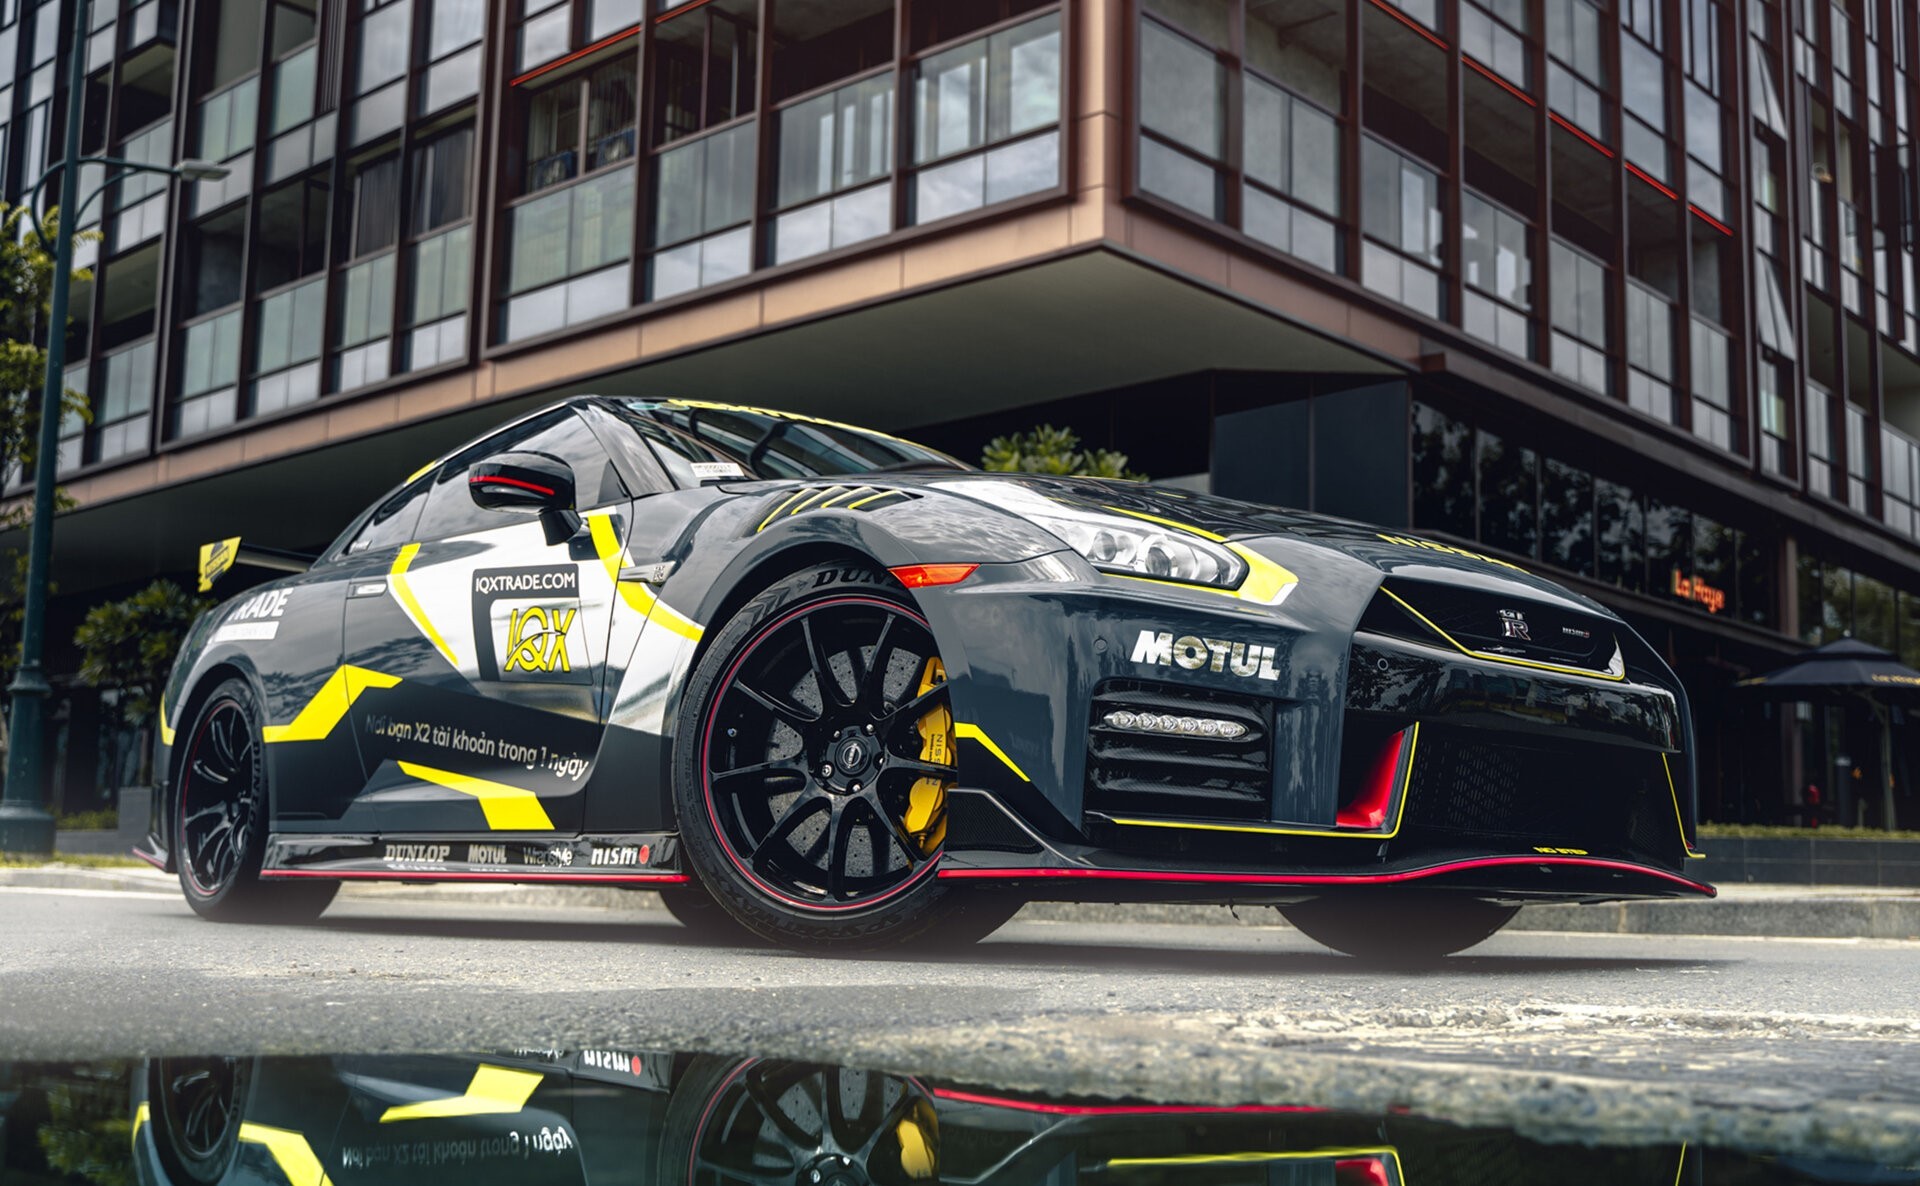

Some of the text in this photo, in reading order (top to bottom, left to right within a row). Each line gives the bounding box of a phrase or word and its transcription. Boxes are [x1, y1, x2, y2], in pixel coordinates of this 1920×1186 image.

[475, 572, 576, 594] IQXTRADE.COM
[1129, 629, 1281, 681] MOTUL
[387, 719, 413, 742] bạn
[413, 722, 431, 744] X2
[432, 726, 451, 748] tài
[452, 728, 496, 756] khoản
[498, 739, 537, 770] trong
[540, 746, 548, 768] 1
[548, 751, 590, 781] ngày
[383, 844, 451, 863] DUNLOP
[467, 844, 507, 864] MOTUL
